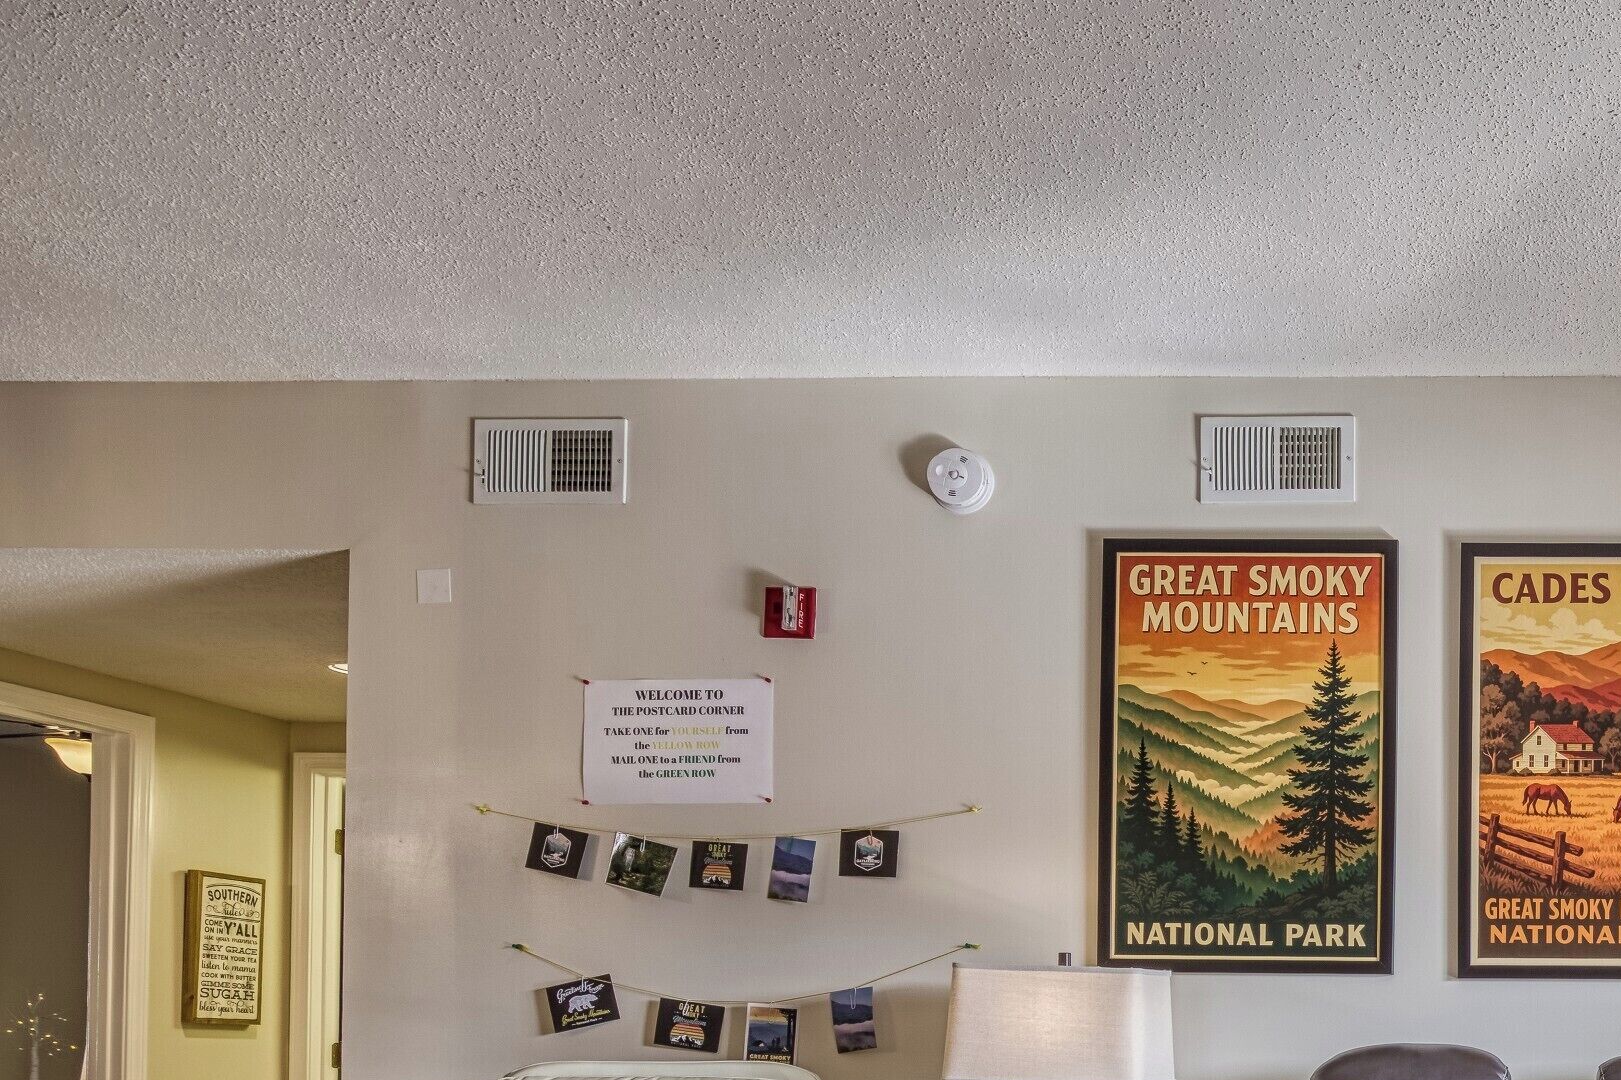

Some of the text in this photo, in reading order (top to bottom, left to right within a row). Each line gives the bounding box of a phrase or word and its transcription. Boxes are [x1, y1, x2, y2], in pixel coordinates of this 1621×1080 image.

[1128, 564, 1373, 597] GREAT SMOKY
[1491, 572, 1611, 604] CADES
[1141, 601, 1360, 634] MOUNTAINS
[635, 689, 724, 701] WELCOME TO
[612, 705, 745, 716] THE POSTCARD CORNER
[604, 726, 749, 736] TAKE ONE for YOURSELF from
[634, 741, 721, 750] the YELLOW ROW
[611, 755, 637, 764] MAIL
[637, 755, 659, 764] ONE
[660, 756, 670, 764] to
[678, 755, 716, 764] FRIEND
[717, 754, 741, 764] from
[638, 769, 717, 778] the GREEN ROW
[207, 888, 259, 908] SOUTHERN
[1484, 897, 1544, 921] GREAT
[1549, 898, 1614, 921] SMOKY
[204, 918, 258, 938] COME Y'ALL
[204, 926, 224, 935] ON IN
[1126, 922, 1367, 948] NATIONAL PARK
[202, 943, 258, 956] SAY GRACE
[201, 971, 219, 979] COOK
[200, 987, 255, 1001] SUGAH
